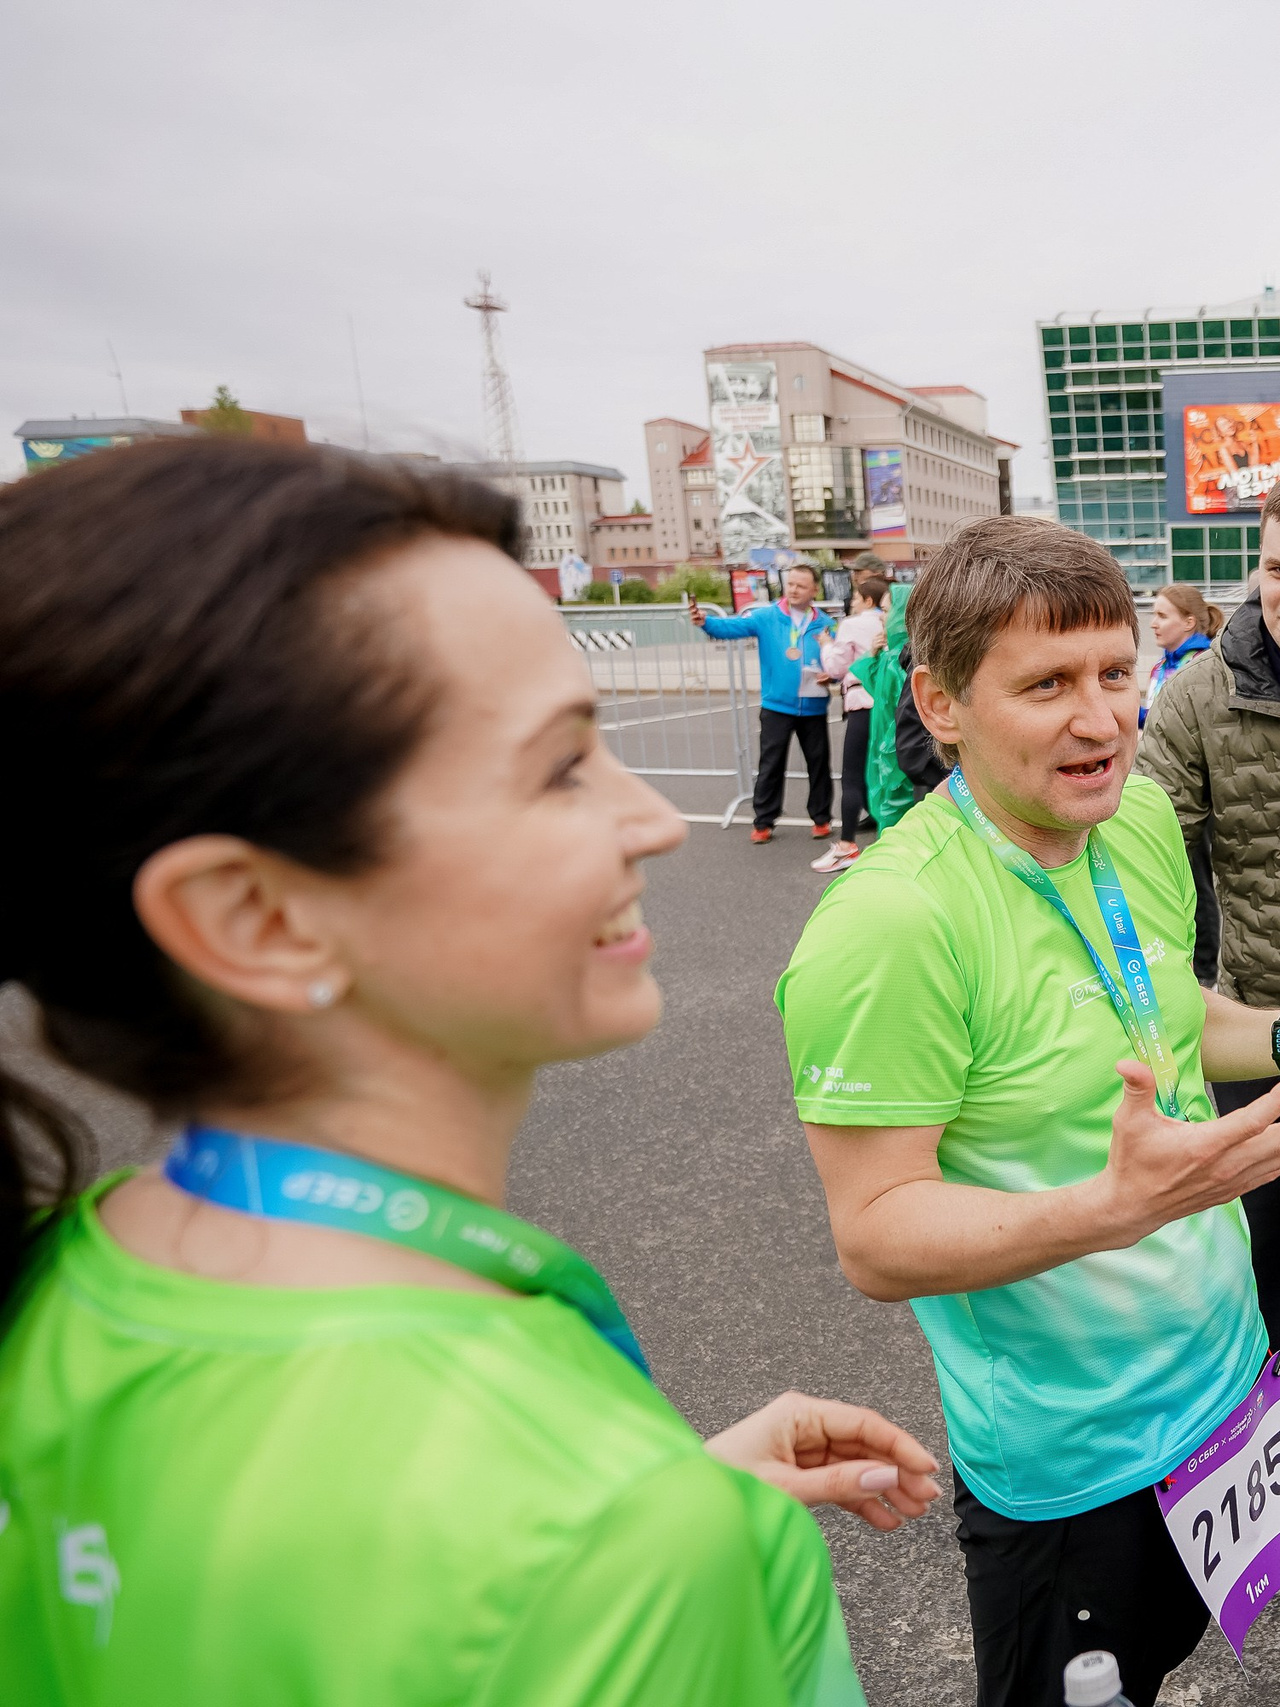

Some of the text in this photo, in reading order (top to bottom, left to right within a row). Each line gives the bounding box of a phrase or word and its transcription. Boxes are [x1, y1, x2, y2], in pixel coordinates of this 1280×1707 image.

[1237, 477, 1277, 500] БЭН
[954, 774, 970, 797] СБЕР
[972, 806, 987, 825] 185
[1112, 911, 1127, 935] Utair
[1134, 975, 1150, 1007] СБЕР
[1147, 1019, 1160, 1041] 185
[1154, 1042, 1165, 1063] лет
[1198, 1442, 1219, 1463] СБЕР
